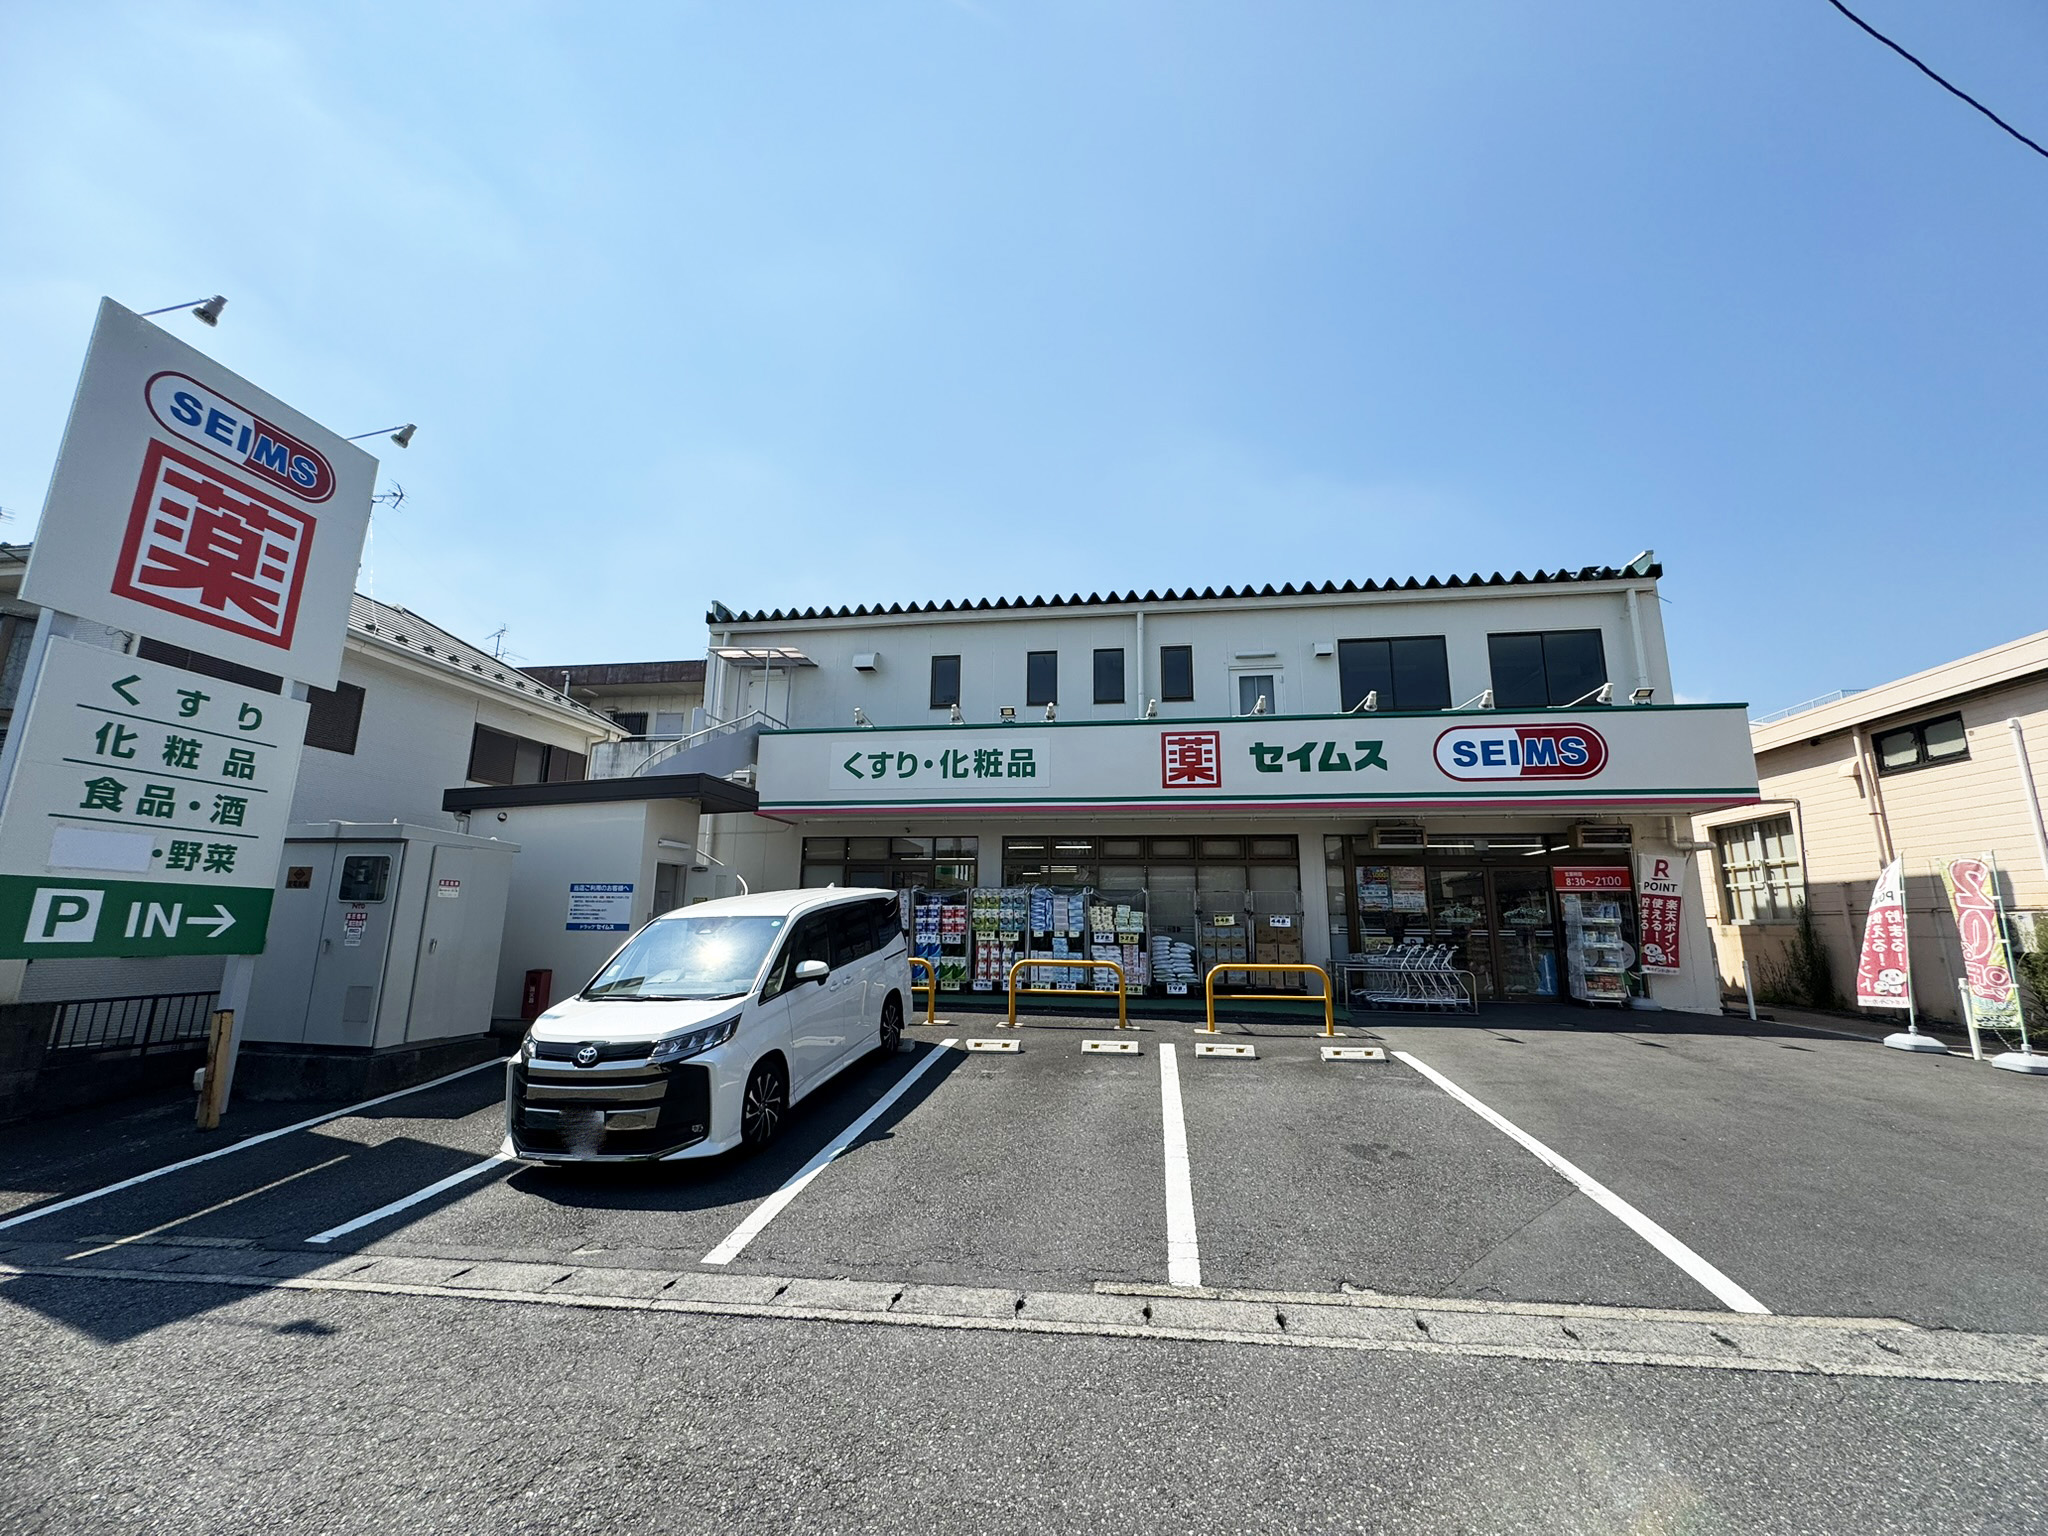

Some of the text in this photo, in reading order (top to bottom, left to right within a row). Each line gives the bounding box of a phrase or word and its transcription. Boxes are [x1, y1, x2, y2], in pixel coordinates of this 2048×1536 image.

[170, 391, 317, 490] SEIMS
[138, 468, 298, 628] 薬
[112, 675, 263, 732] くすり
[95, 722, 255, 780] 化粧品
[843, 748, 1037, 779] くすり・化粧品
[1167, 737, 1216, 782] 薬
[1249, 740, 1388, 773] セイムス
[1452, 736, 1590, 767] SEIMS
[80, 776, 247, 827] 食品・酒
[1644, 882, 1678, 892] POINT
[42, 896, 183, 937] P IN
[1664, 900, 1678, 963] 楽天ポイント
